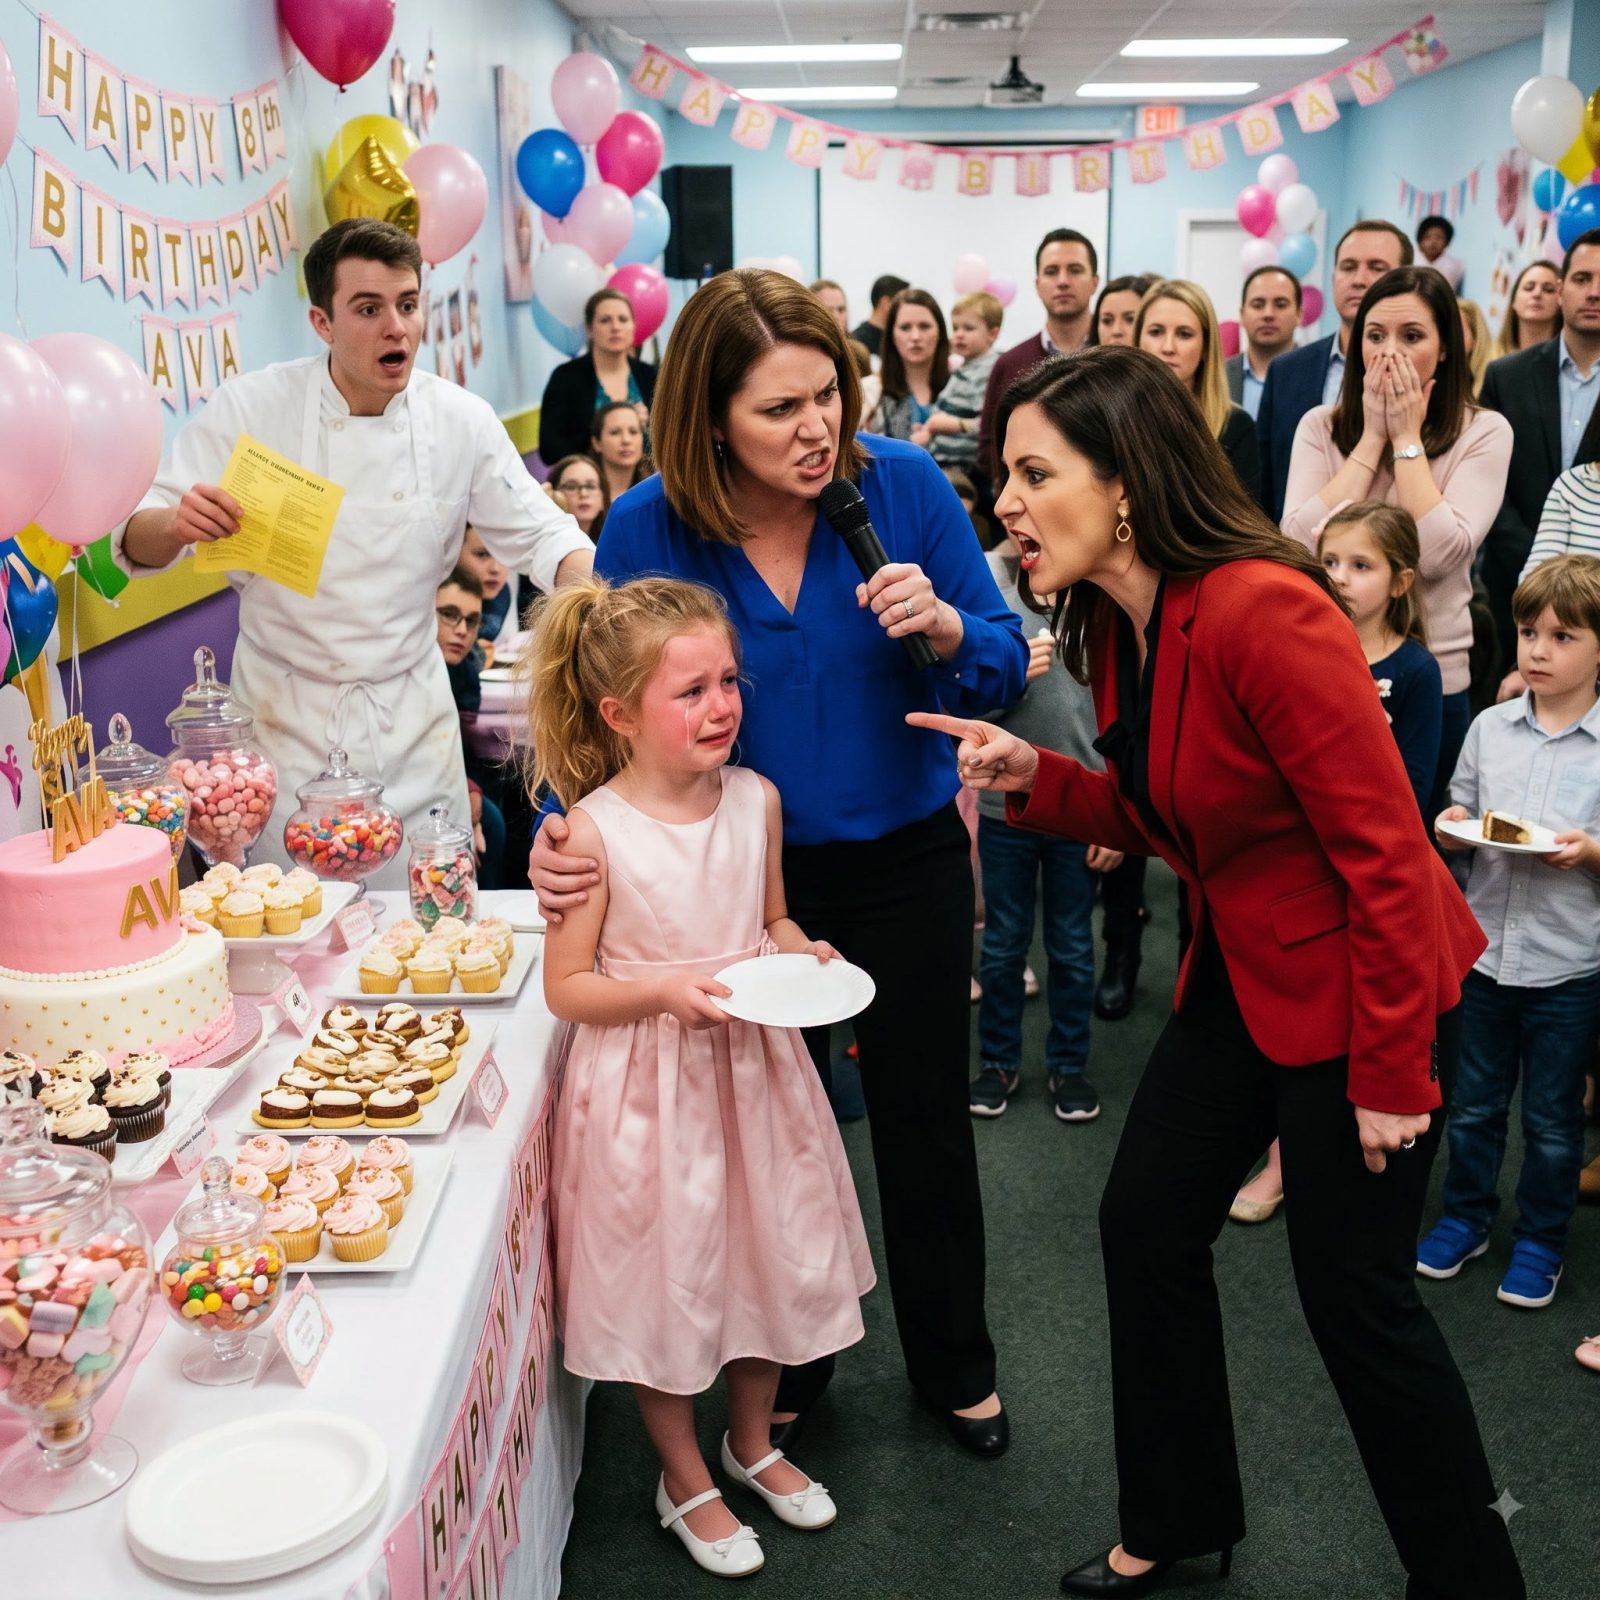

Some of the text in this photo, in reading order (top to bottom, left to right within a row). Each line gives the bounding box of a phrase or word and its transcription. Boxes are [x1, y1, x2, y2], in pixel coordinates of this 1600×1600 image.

[47, 35, 281, 164] HAPPY 8th
[638, 57, 1379, 189] HAPPY BIRTHDAY
[42, 170, 290, 288] BIRTHDAY
[152, 328, 239, 389] AVA
[52, 775, 117, 864] AVA
[432, 1285, 506, 1572] HAPPY
